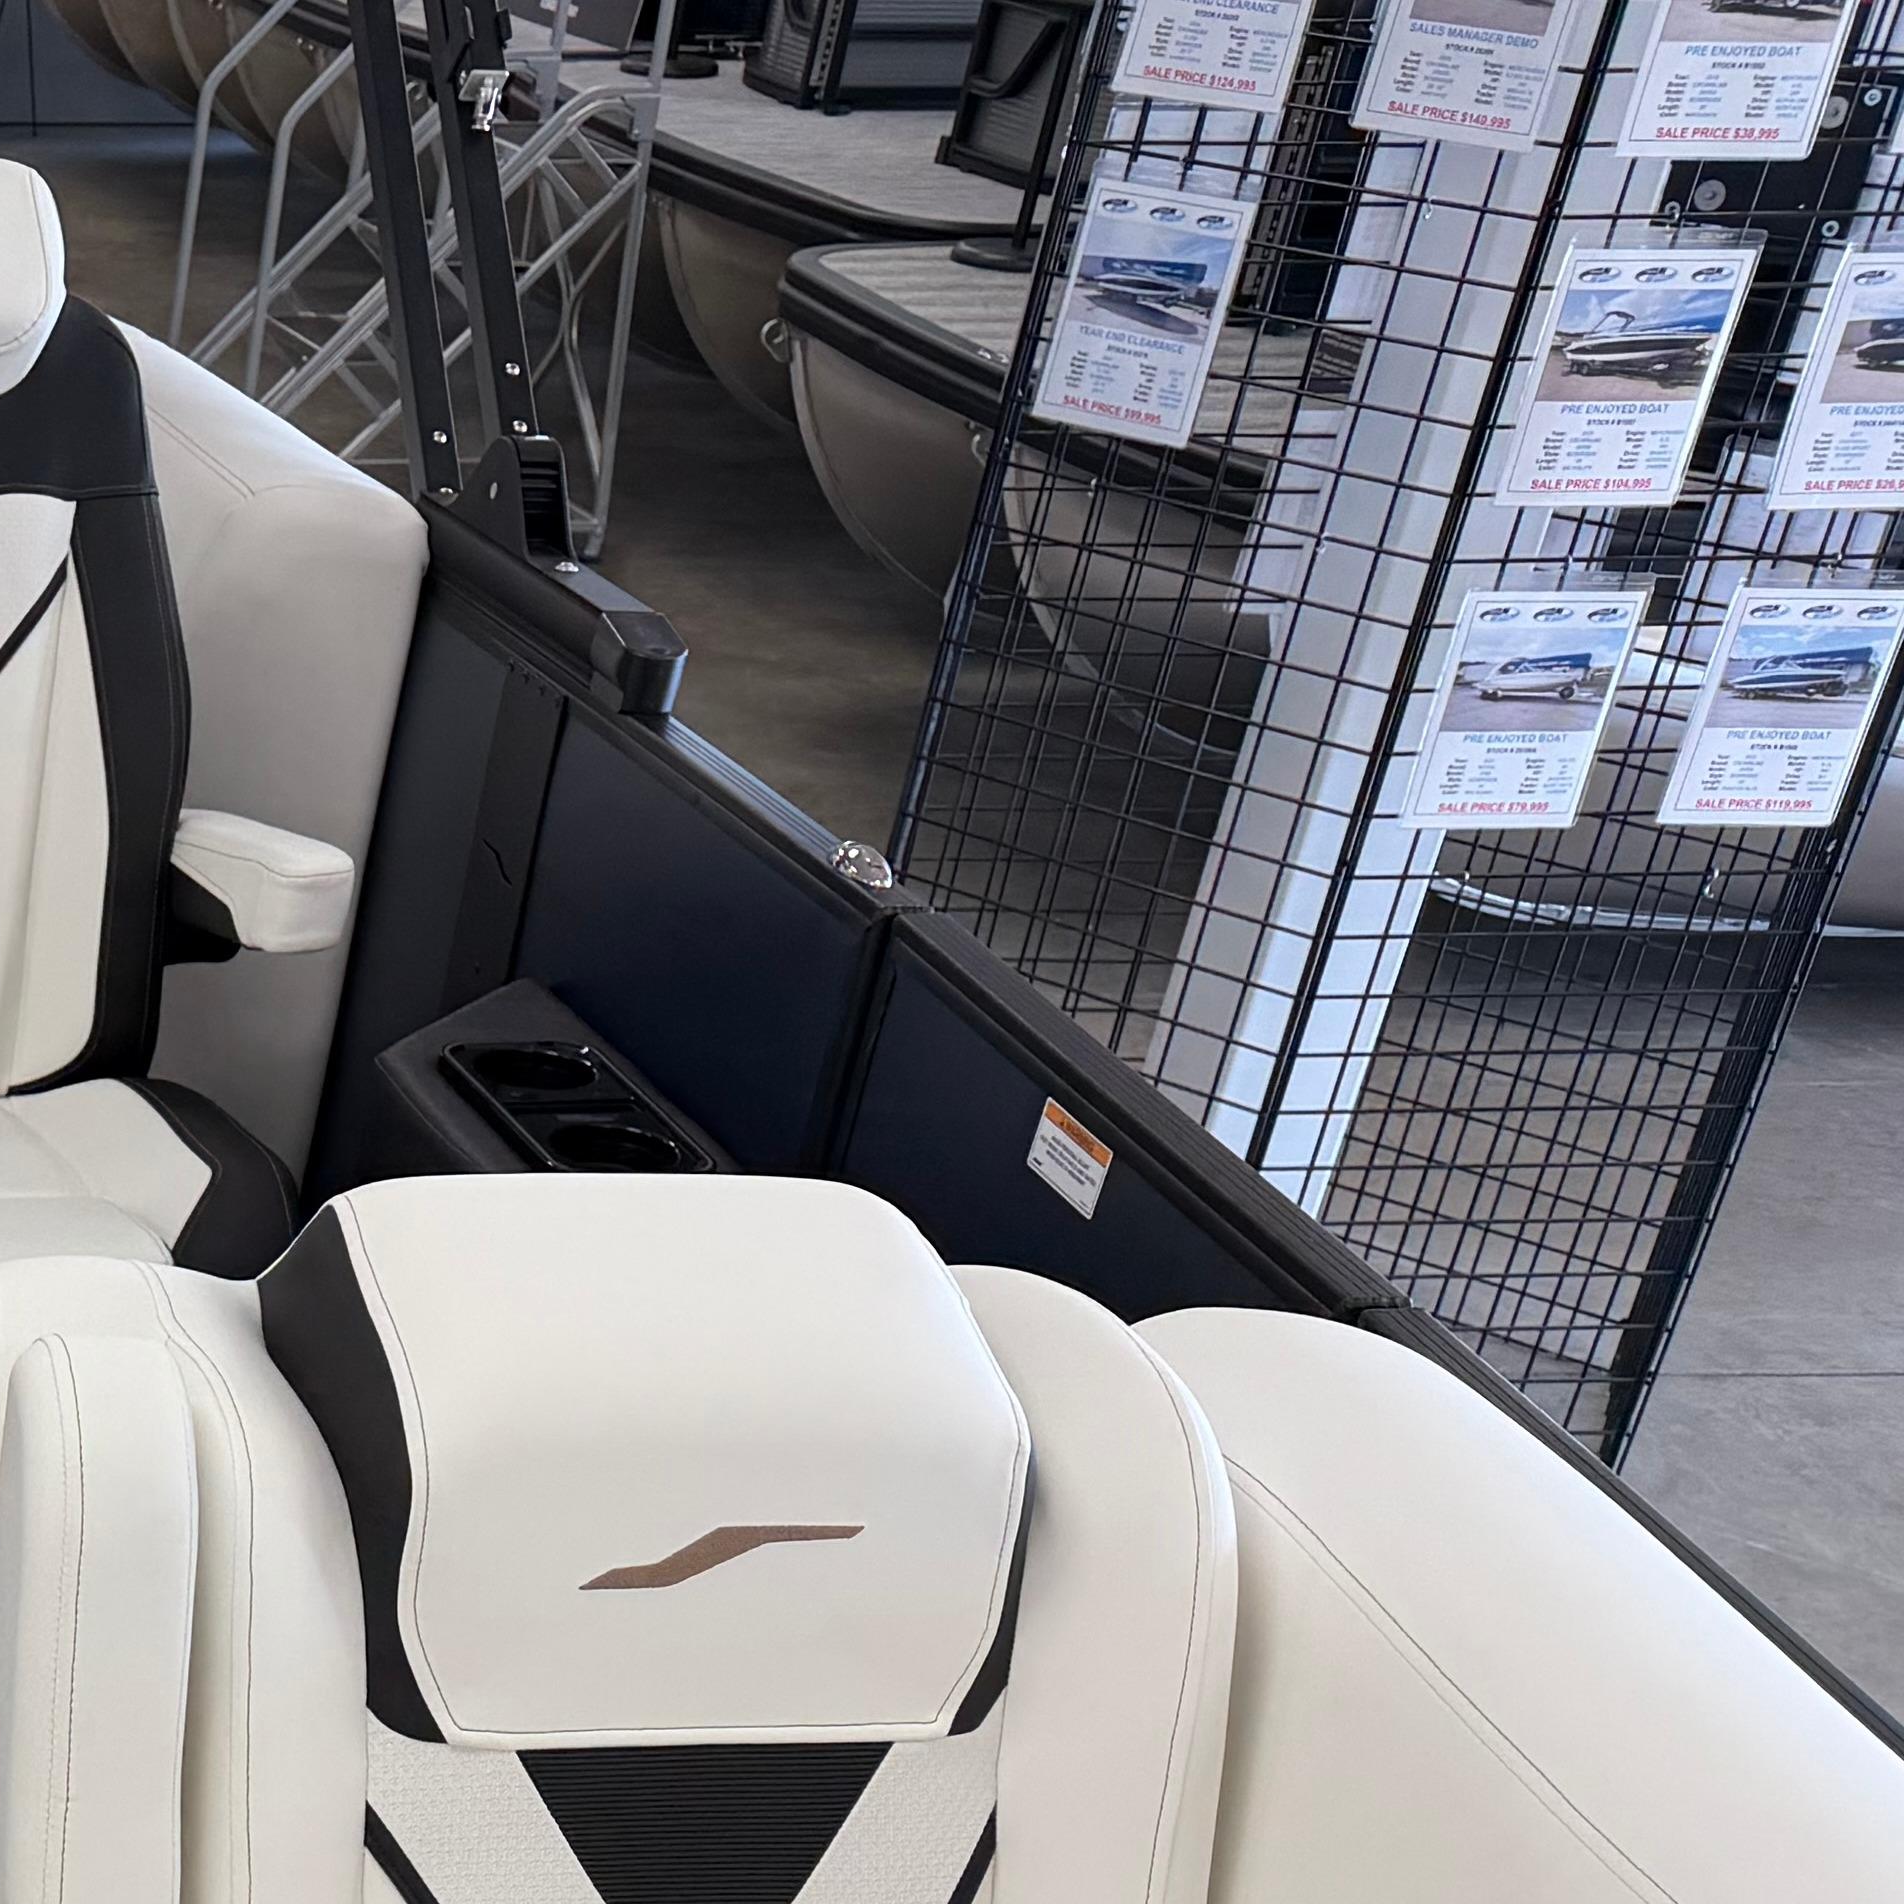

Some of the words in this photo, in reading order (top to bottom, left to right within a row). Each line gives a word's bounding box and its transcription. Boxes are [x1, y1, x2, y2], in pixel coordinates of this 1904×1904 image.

[1684, 45, 1707, 57] PRE
[1710, 45, 1765, 57] ENJOYED
[1767, 45, 1802, 57] BOAT
[1143, 65, 1171, 80] SALE
[1174, 69, 1208, 85] PRICE
[1387, 100, 1419, 116] SALE
[1421, 106, 1459, 122] PRICE
[1656, 127, 1689, 139] SALE
[1691, 127, 1732, 139] PRICE
[1530, 478, 1562, 490] SALE
[1565, 478, 1601, 490] PRICE
[1804, 480, 1836, 491] SALE
[1837, 480, 1873, 490] PRICE
[1695, 799, 1726, 809] SALE
